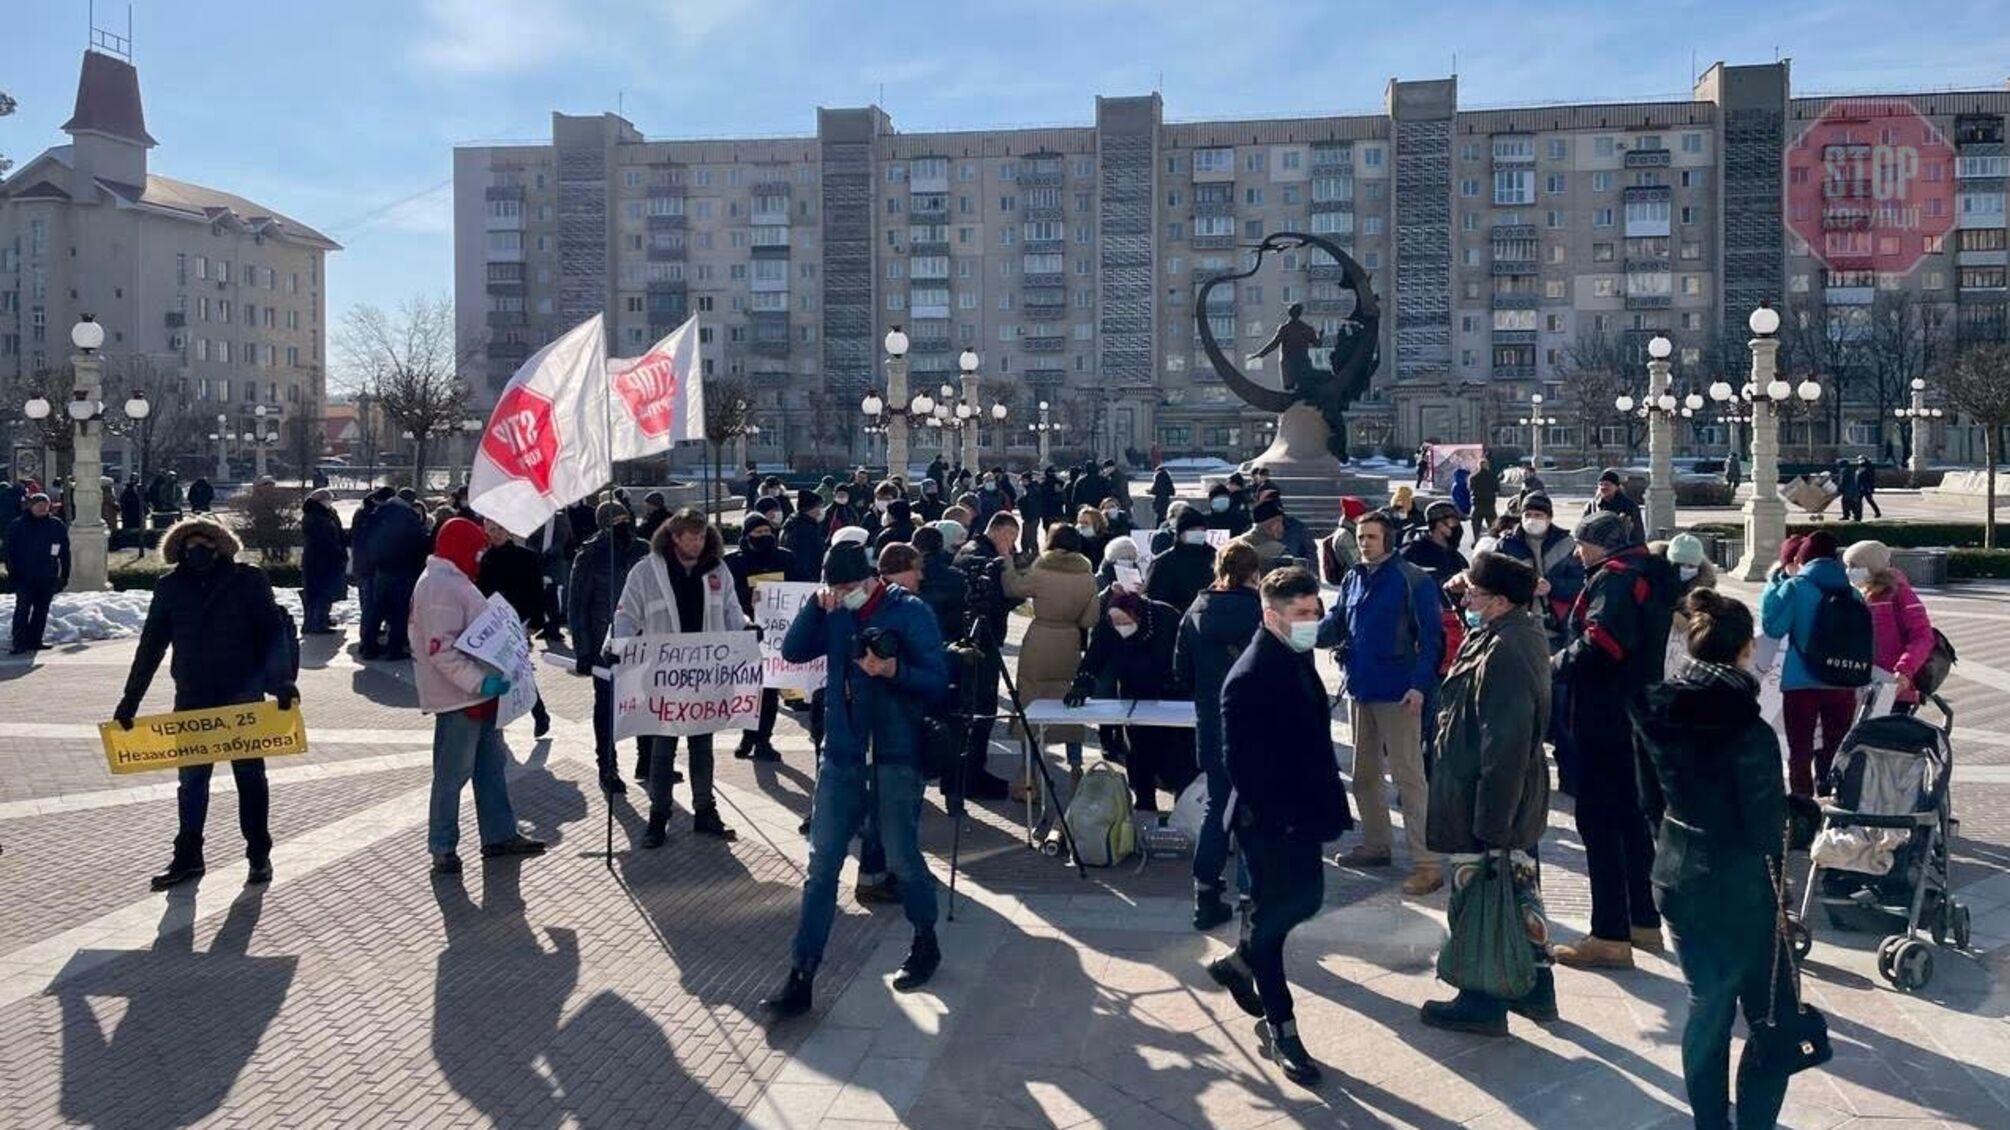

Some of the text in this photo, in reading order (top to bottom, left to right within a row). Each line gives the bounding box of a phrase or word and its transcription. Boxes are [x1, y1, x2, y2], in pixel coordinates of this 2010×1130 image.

[151, 712, 256, 737] ЧЕХОВА, 25
[119, 732, 300, 764] Незаконна забудова!
